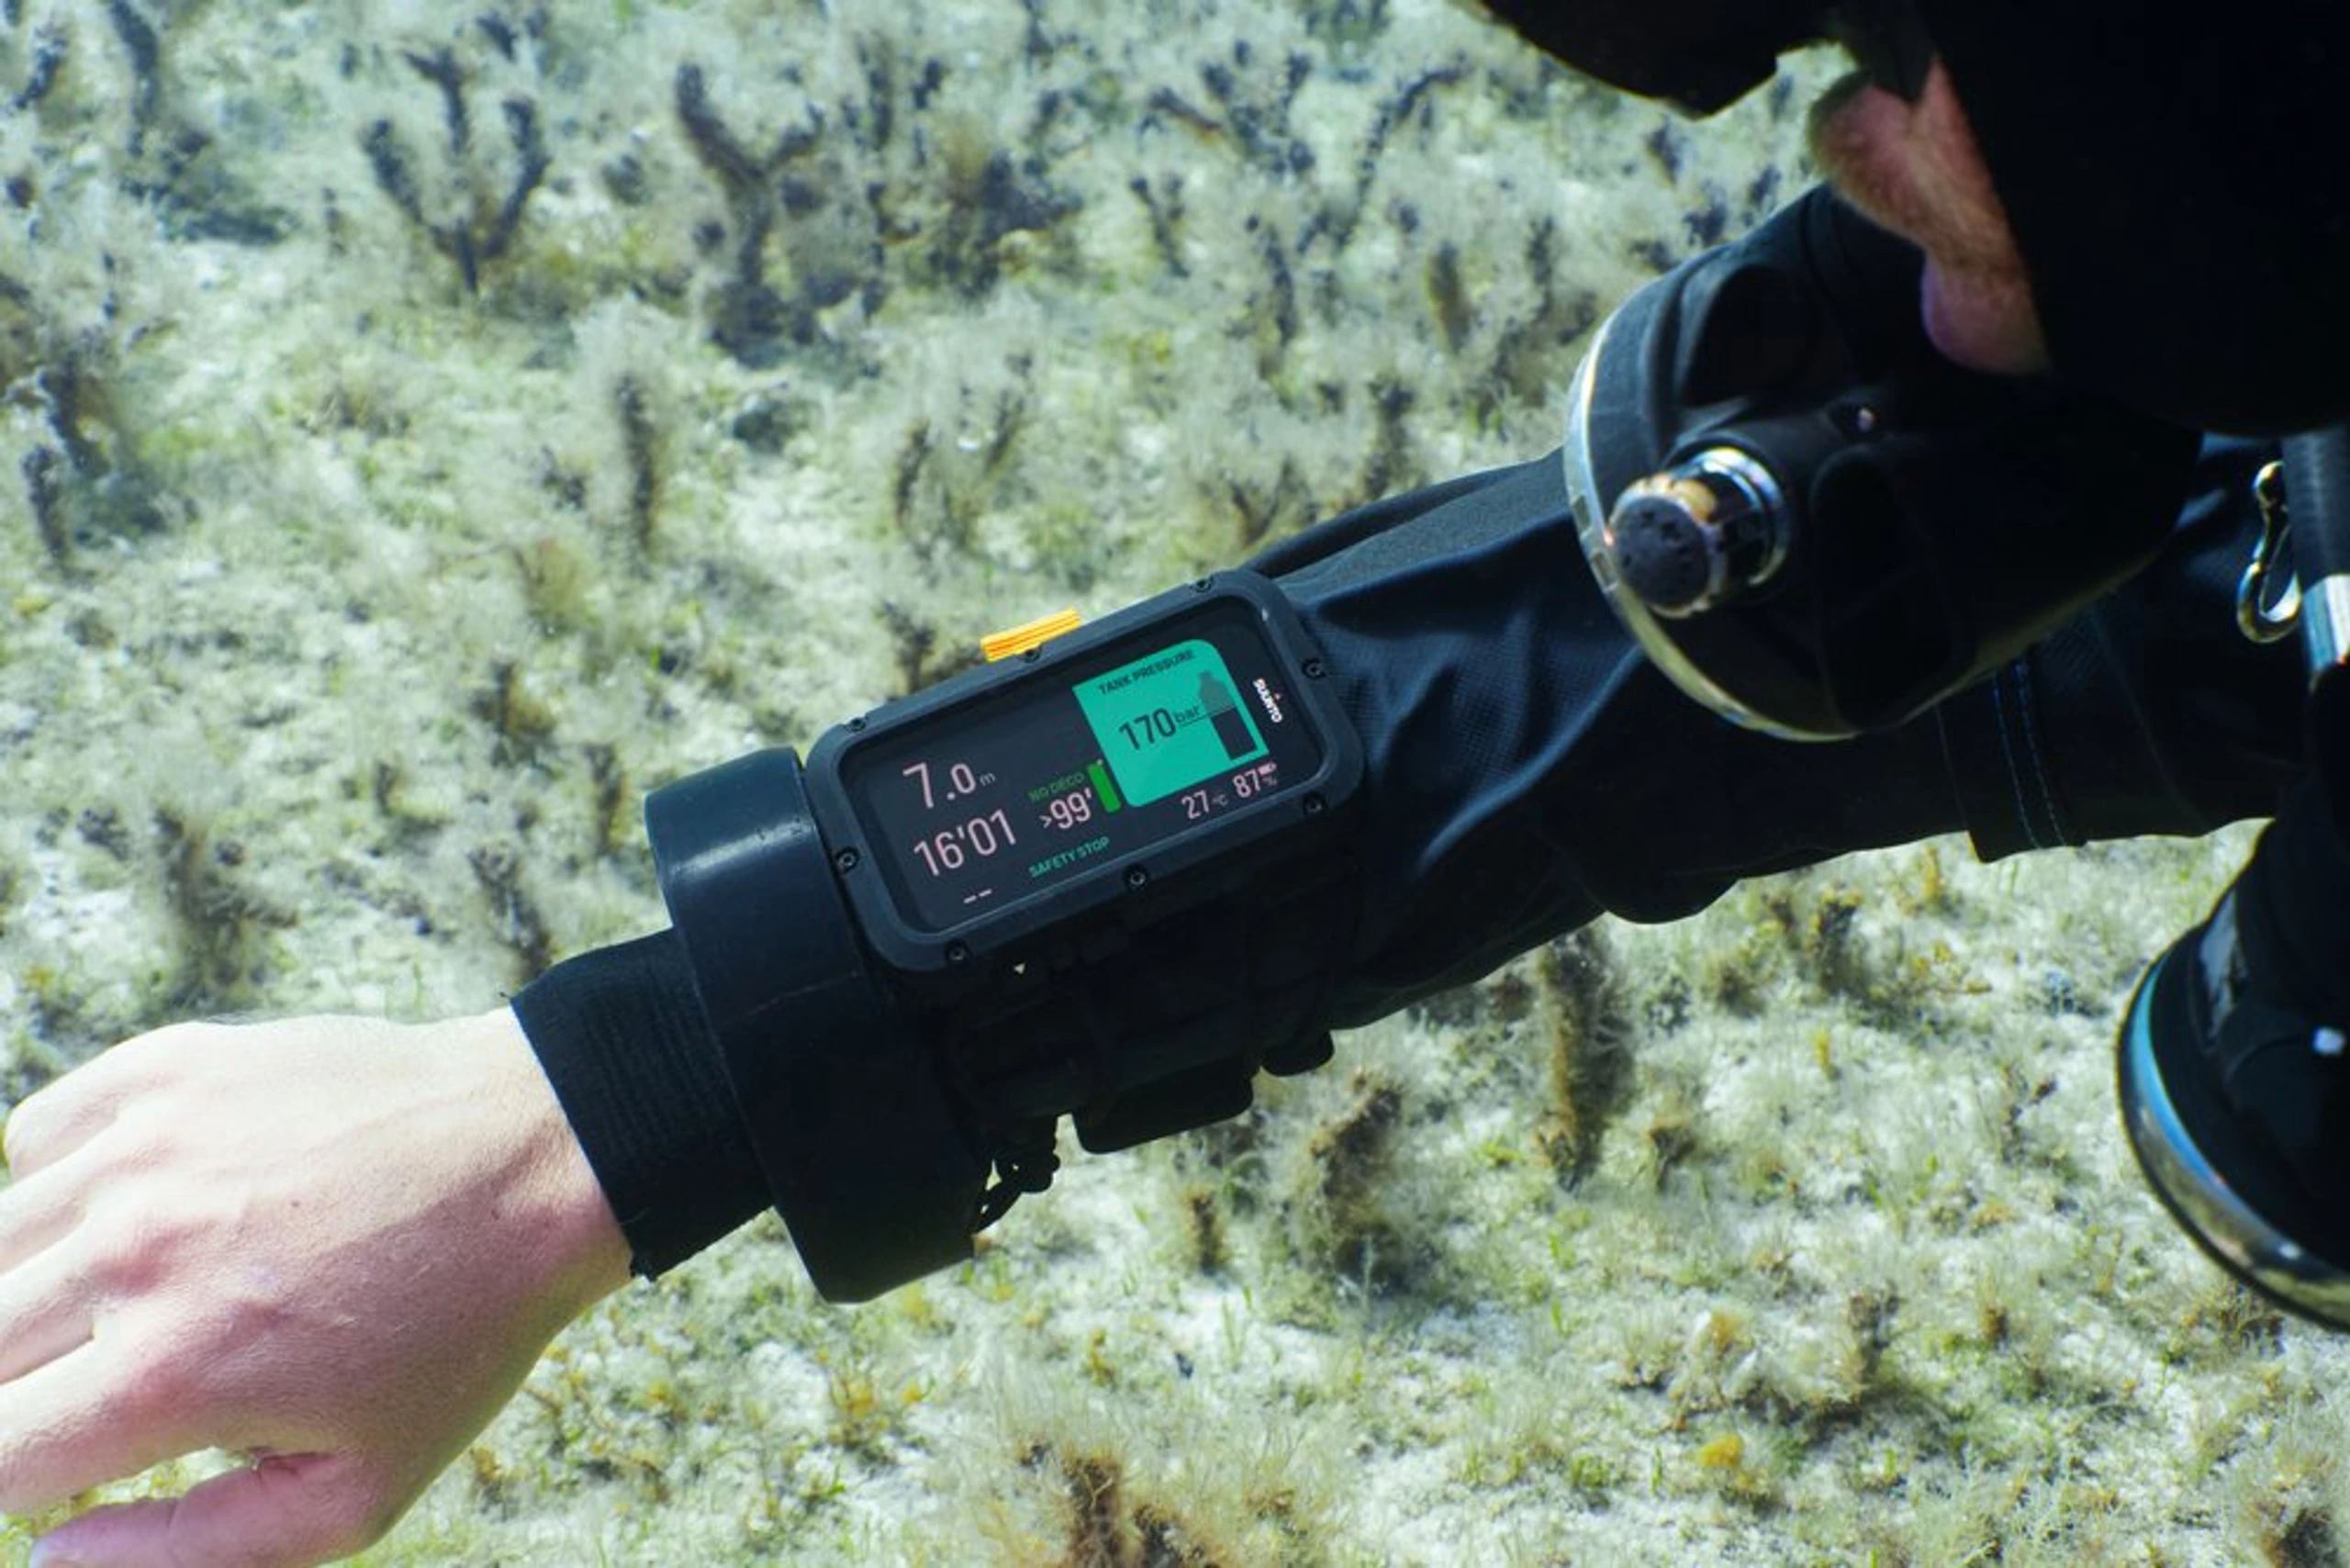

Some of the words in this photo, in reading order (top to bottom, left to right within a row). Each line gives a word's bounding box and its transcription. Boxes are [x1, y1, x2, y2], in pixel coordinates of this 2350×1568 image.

[1100, 676, 1135, 695] TANK
[1134, 650, 1195, 678] PRESSURE
[1253, 678, 1282, 722] SUUNTO
[1119, 708, 1175, 750] 170
[1175, 705, 1201, 723] bar
[902, 762, 977, 809] 7.0
[1028, 787, 1049, 801] NO
[1049, 772, 1085, 795] DECO
[1181, 790, 1210, 820] 27
[1233, 769, 1261, 798] 87
[1029, 852, 1077, 878] SAFETY
[1078, 836, 1110, 857] STOP
